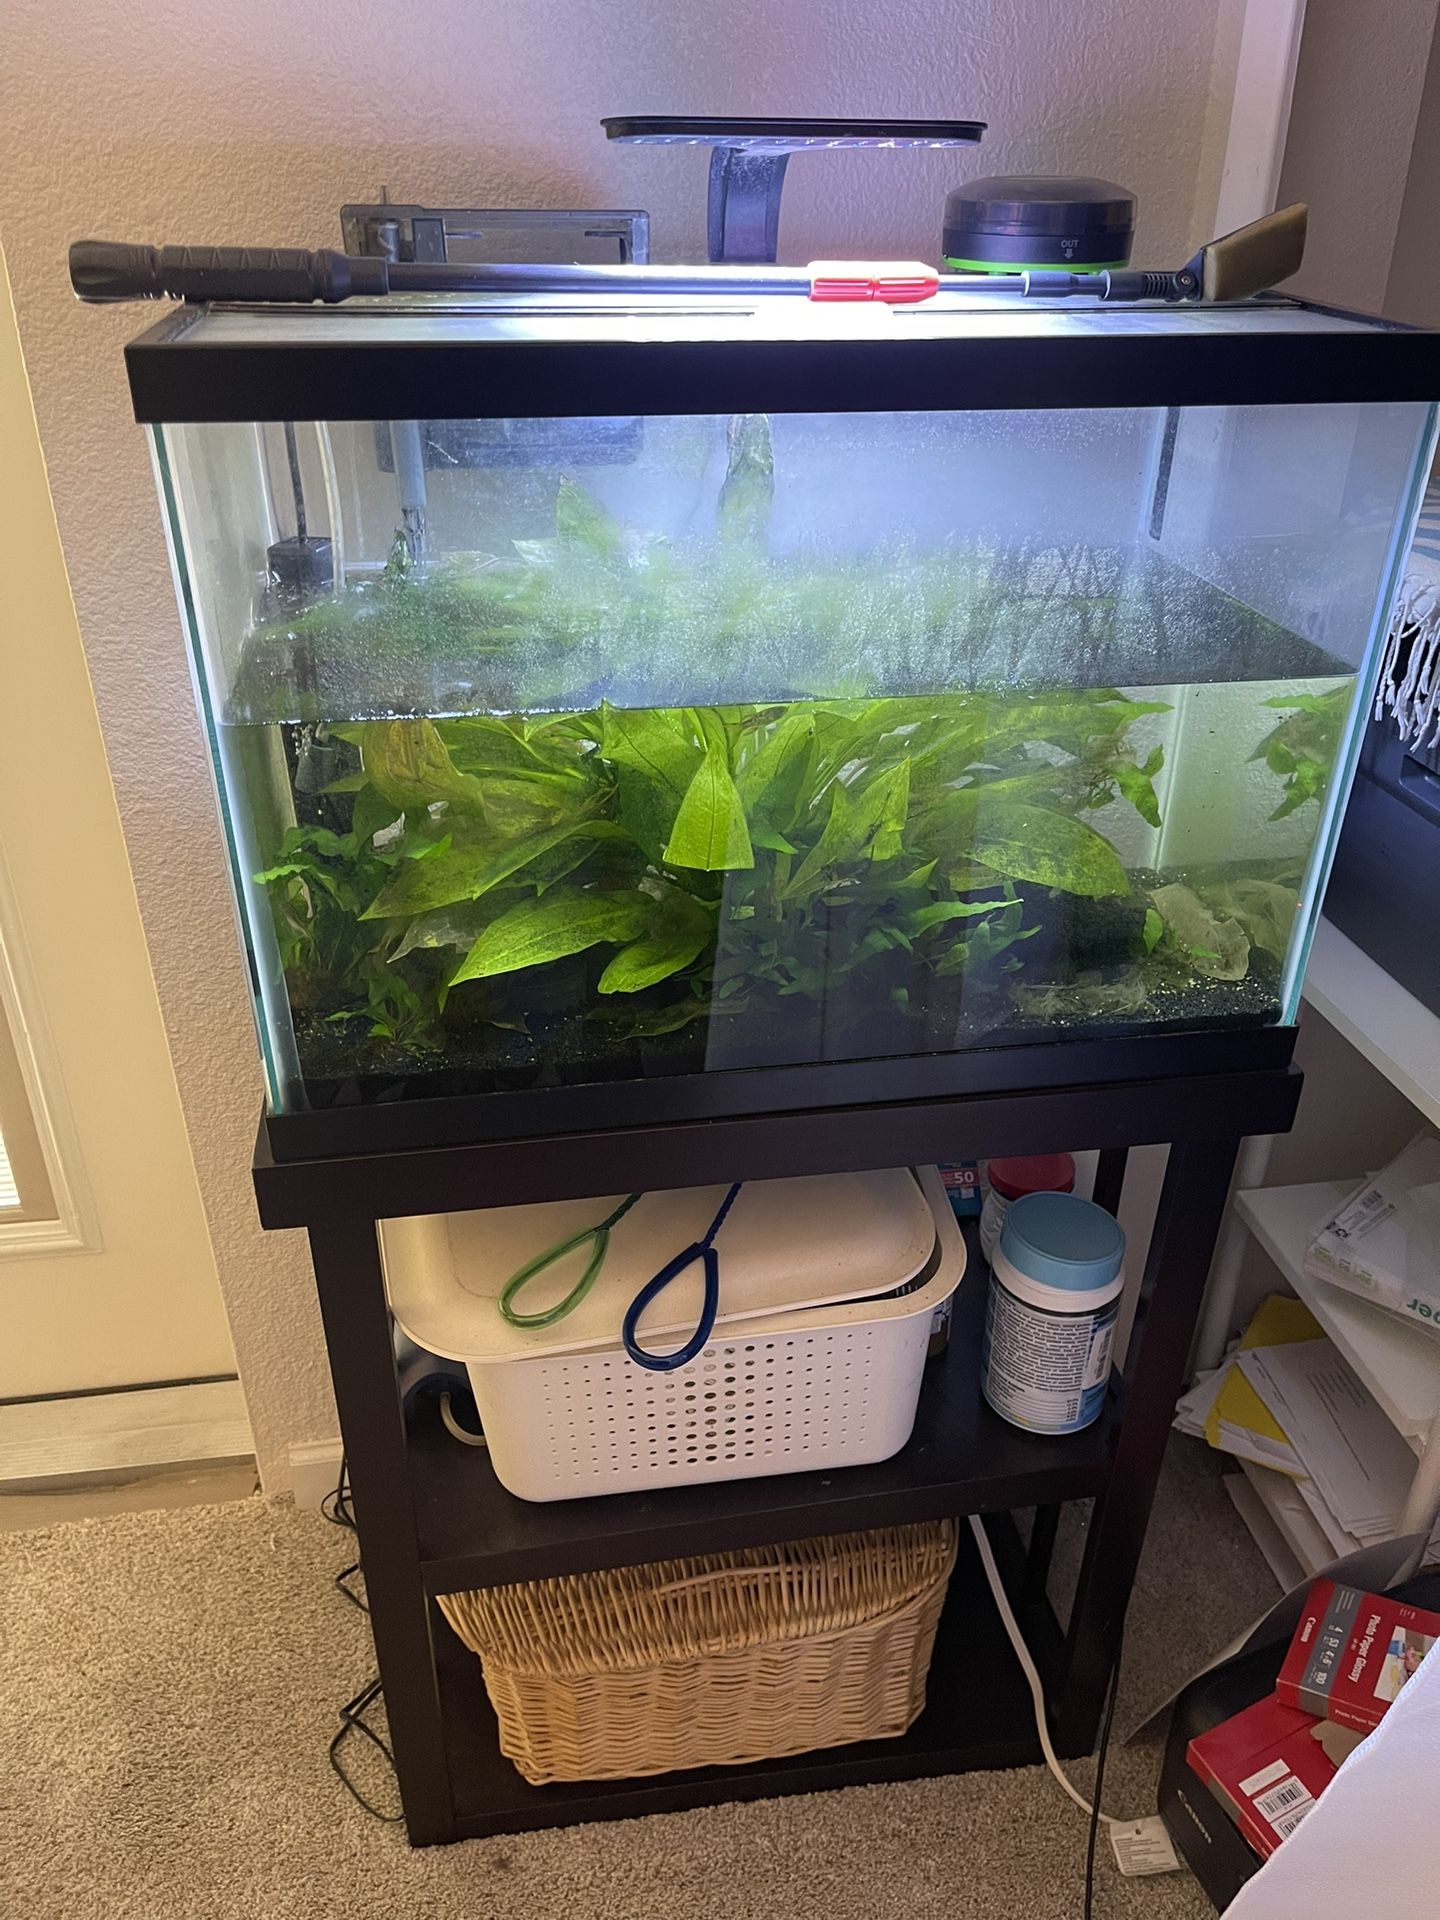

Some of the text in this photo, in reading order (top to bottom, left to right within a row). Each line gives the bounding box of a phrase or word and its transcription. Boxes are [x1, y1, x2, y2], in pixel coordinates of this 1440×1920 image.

[1061, 240, 1079, 248] OUT
[954, 1171, 975, 1184] 50
[1300, 1616, 1317, 1643] Canon
[1366, 1614, 1381, 1639] Photo
[1358, 1635, 1374, 1658] Paper
[1348, 1658, 1367, 1682] Glossy
[1177, 1789, 1212, 1844] Canon
